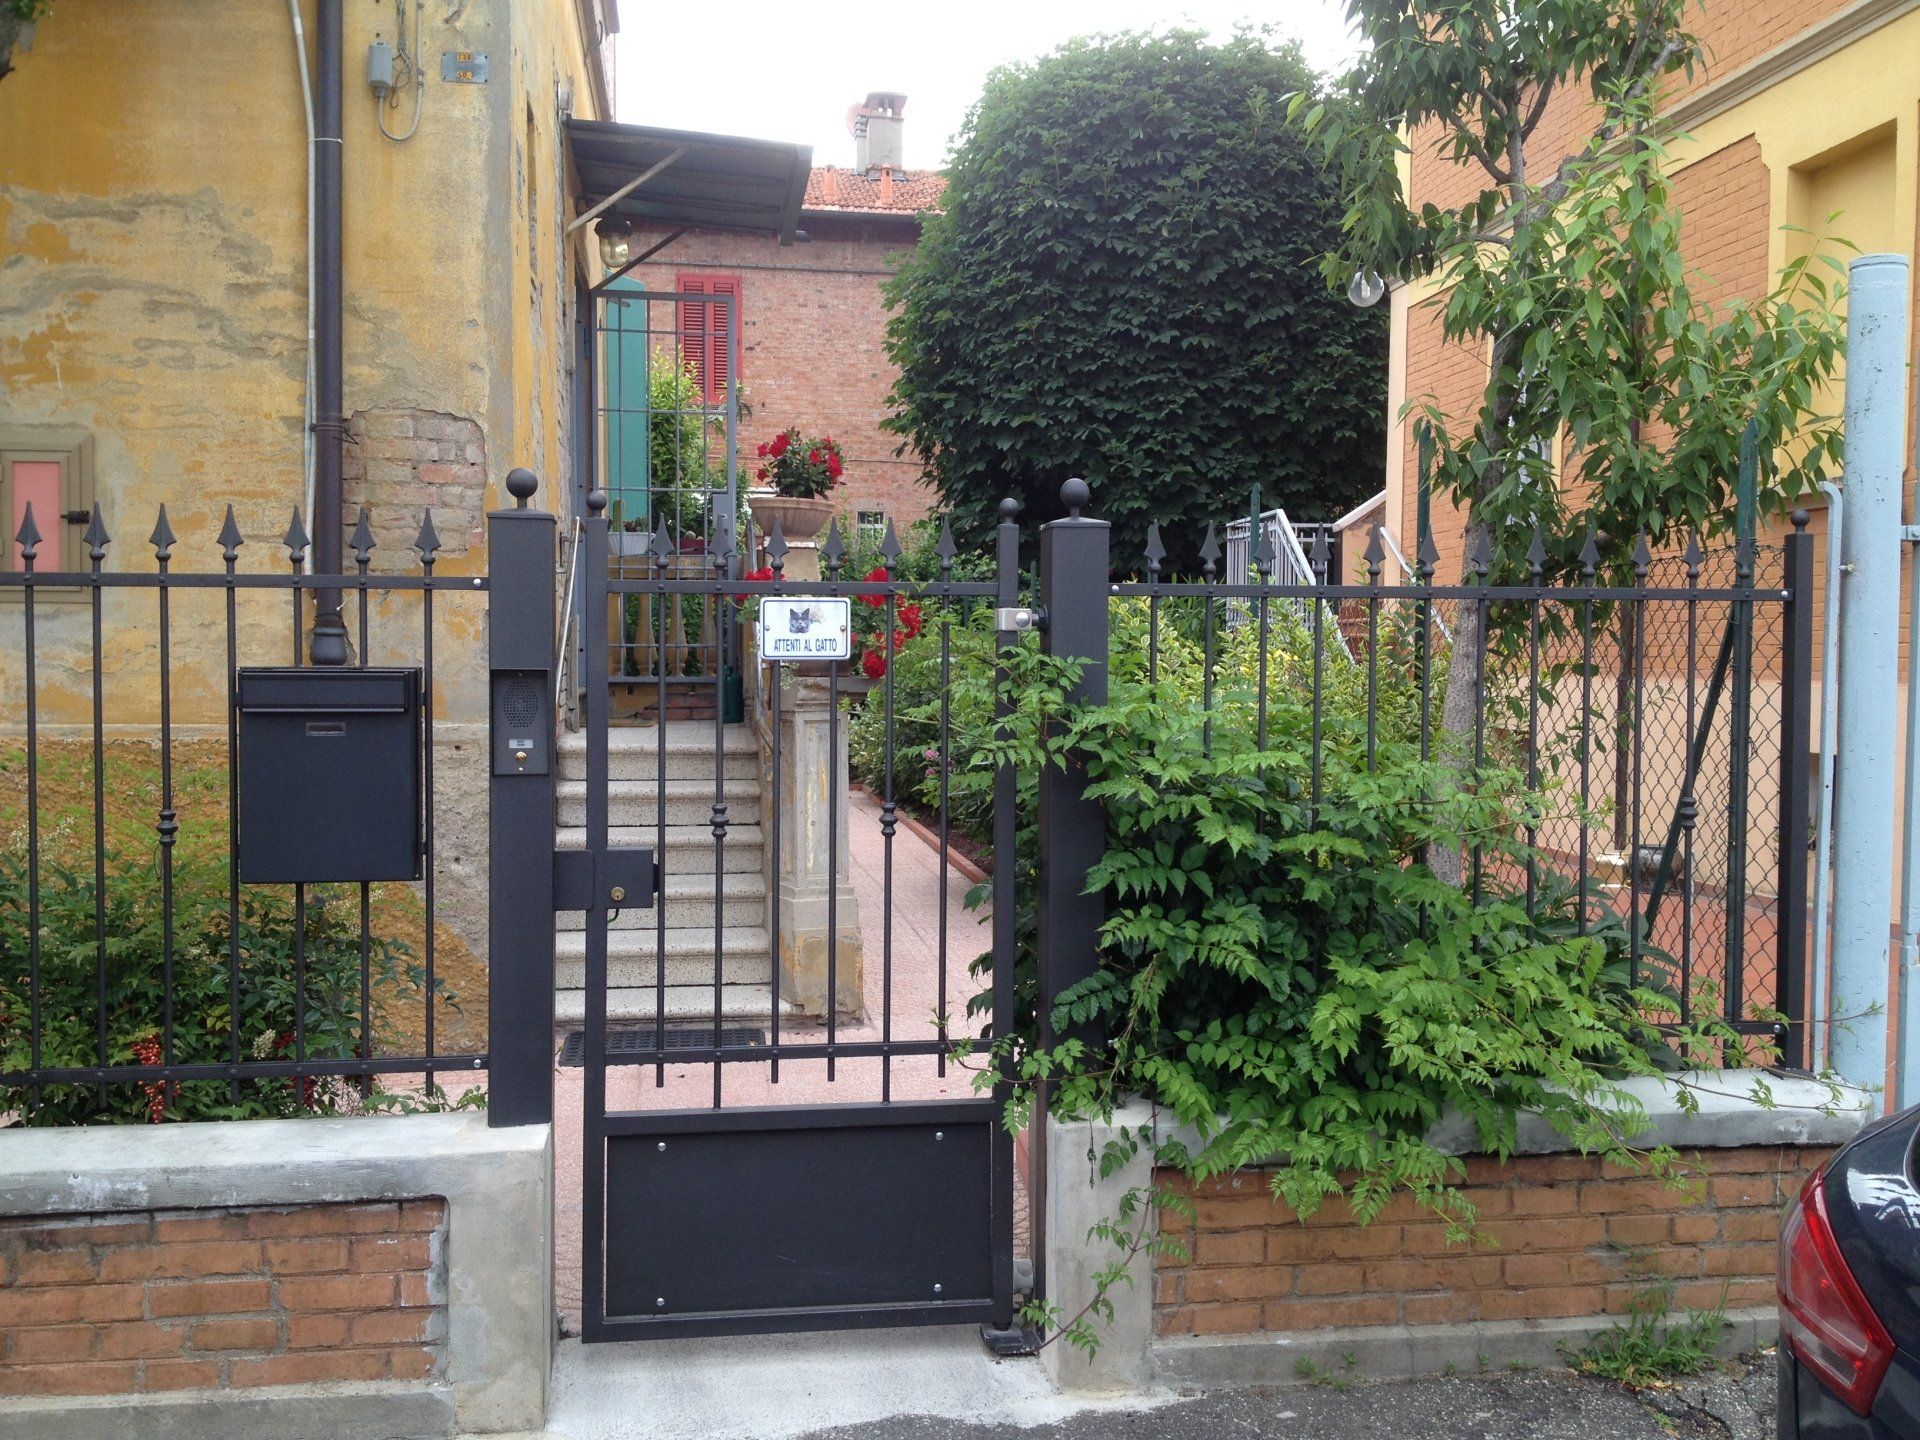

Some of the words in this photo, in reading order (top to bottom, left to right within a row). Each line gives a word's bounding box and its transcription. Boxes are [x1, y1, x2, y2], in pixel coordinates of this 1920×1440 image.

[774, 639, 801, 652] ATTENTI
[804, 639, 812, 652] AL
[815, 638, 837, 652] GATTO
